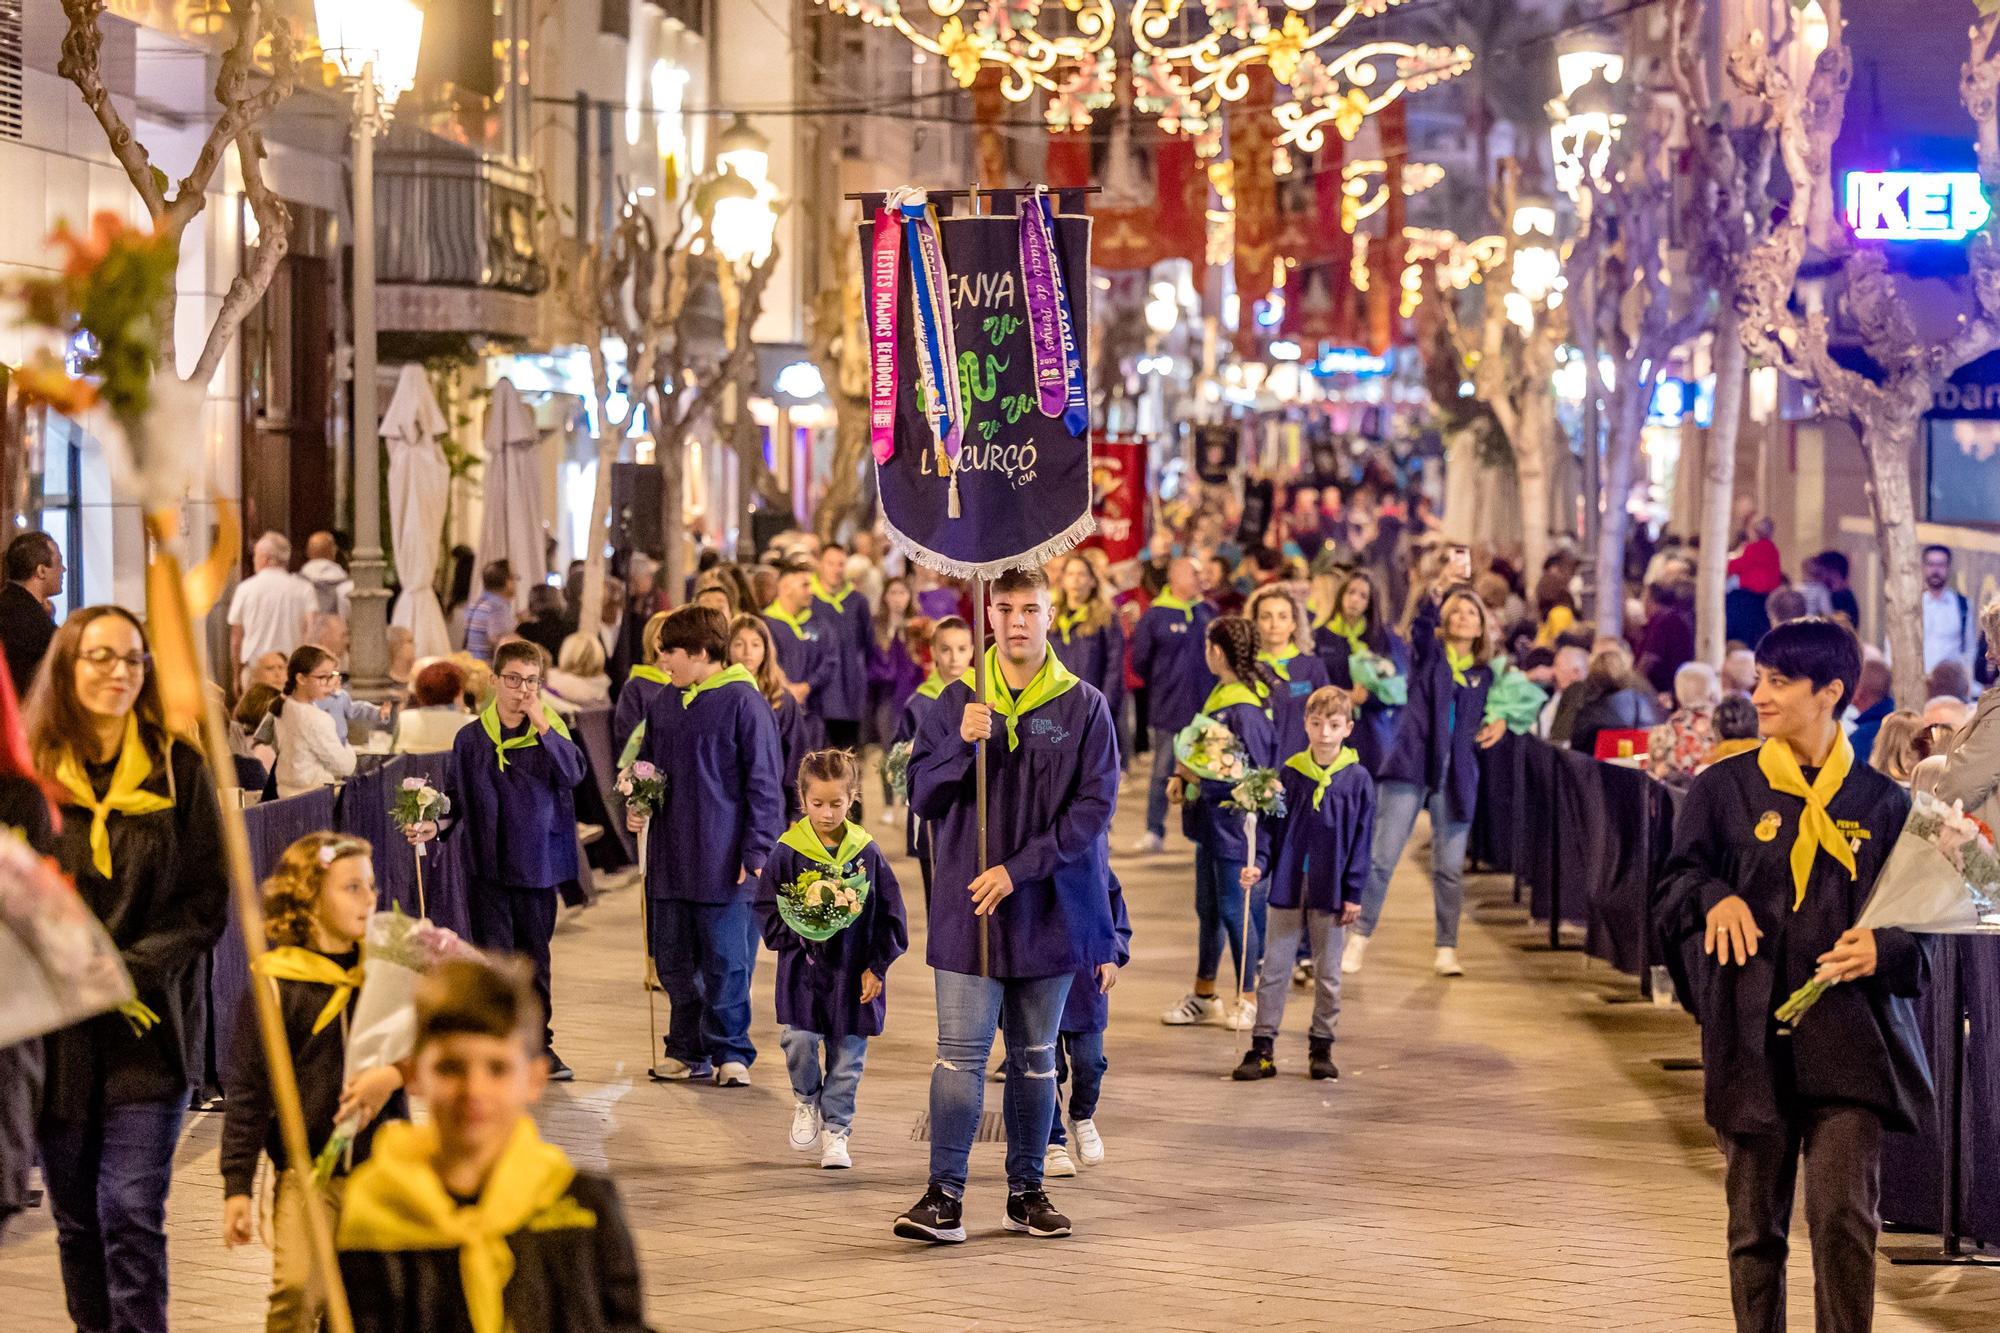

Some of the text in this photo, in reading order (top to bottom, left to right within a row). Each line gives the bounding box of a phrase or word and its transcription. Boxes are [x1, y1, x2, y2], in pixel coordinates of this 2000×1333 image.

[876, 249, 895, 288] FESTES
[948, 270, 1015, 310] ENYA
[1035, 285, 1050, 300] de
[875, 292, 893, 338] MAJORS
[1040, 307, 1054, 352] Penyes
[920, 437, 1037, 479] LCURÇÓ
